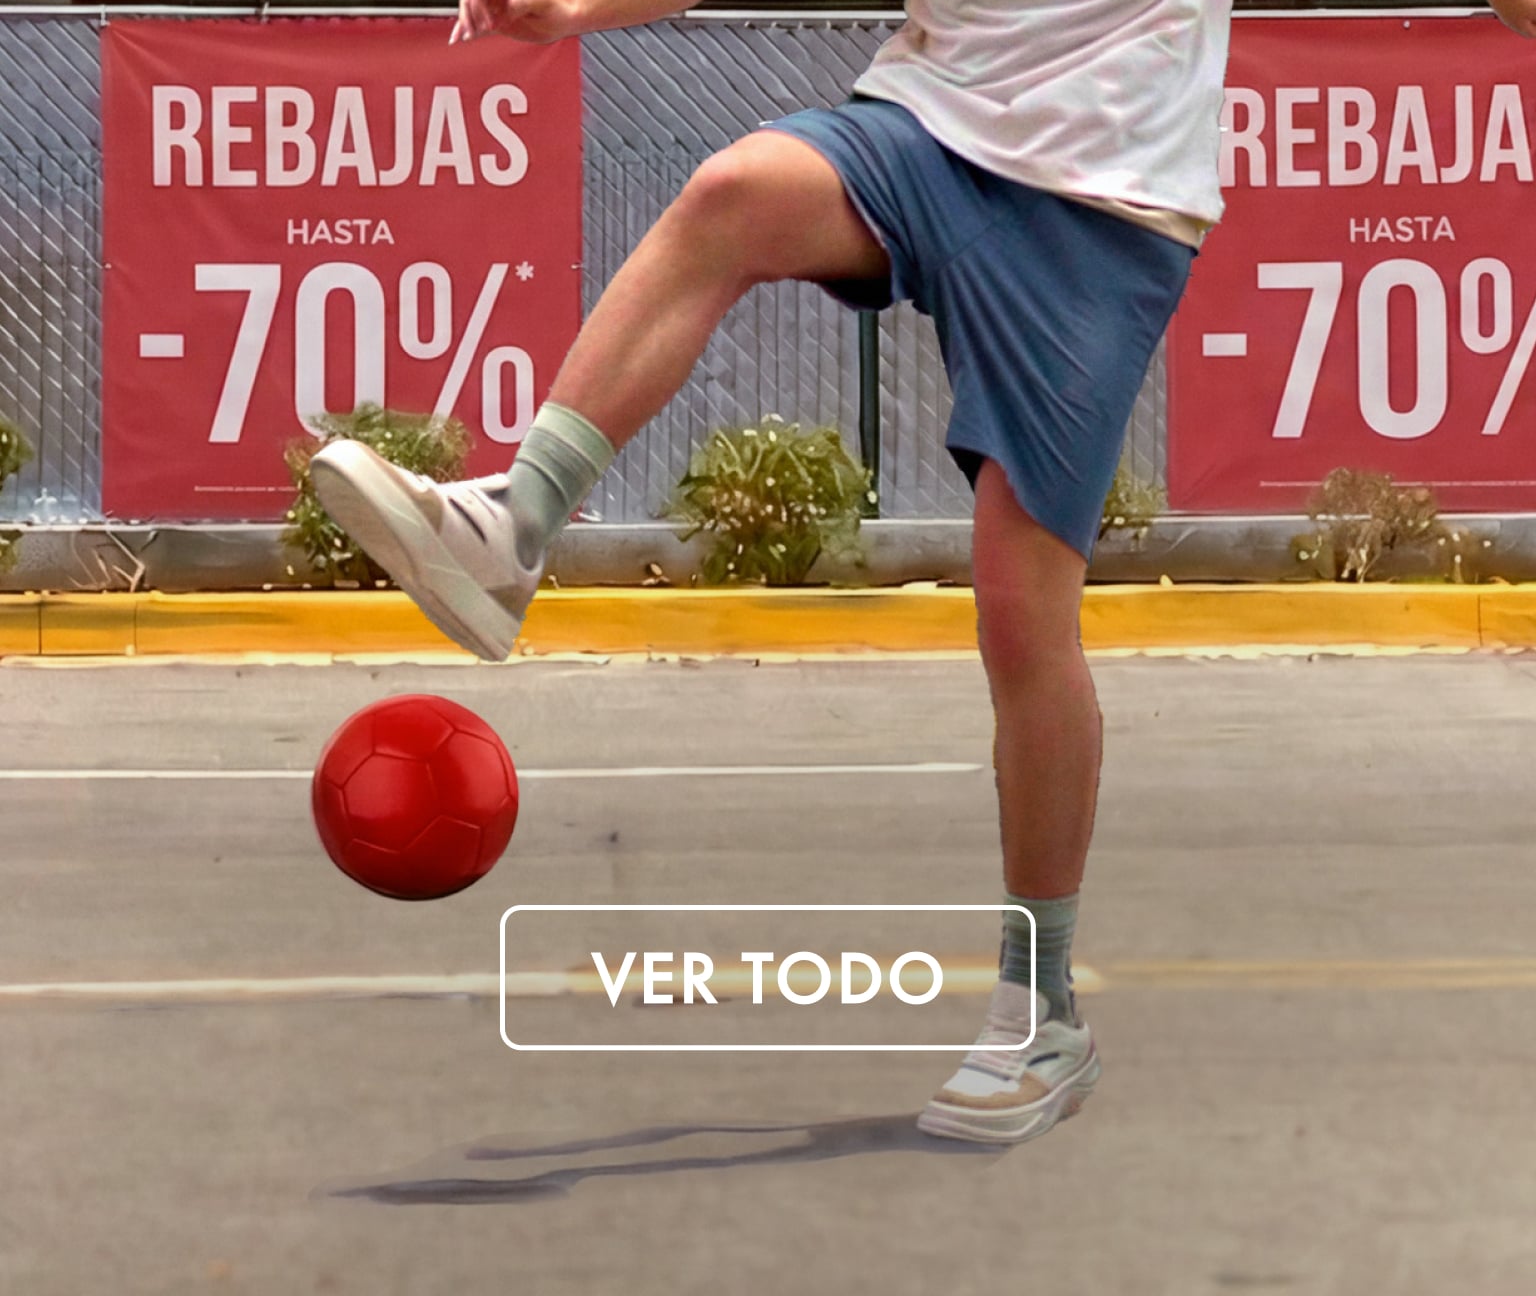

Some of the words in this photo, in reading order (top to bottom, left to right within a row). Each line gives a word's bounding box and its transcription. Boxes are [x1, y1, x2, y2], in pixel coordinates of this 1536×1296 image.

[151, 84, 530, 188] REBAJAS
[286, 218, 395, 246] HASTA
[1349, 216, 1456, 243] HASTA
